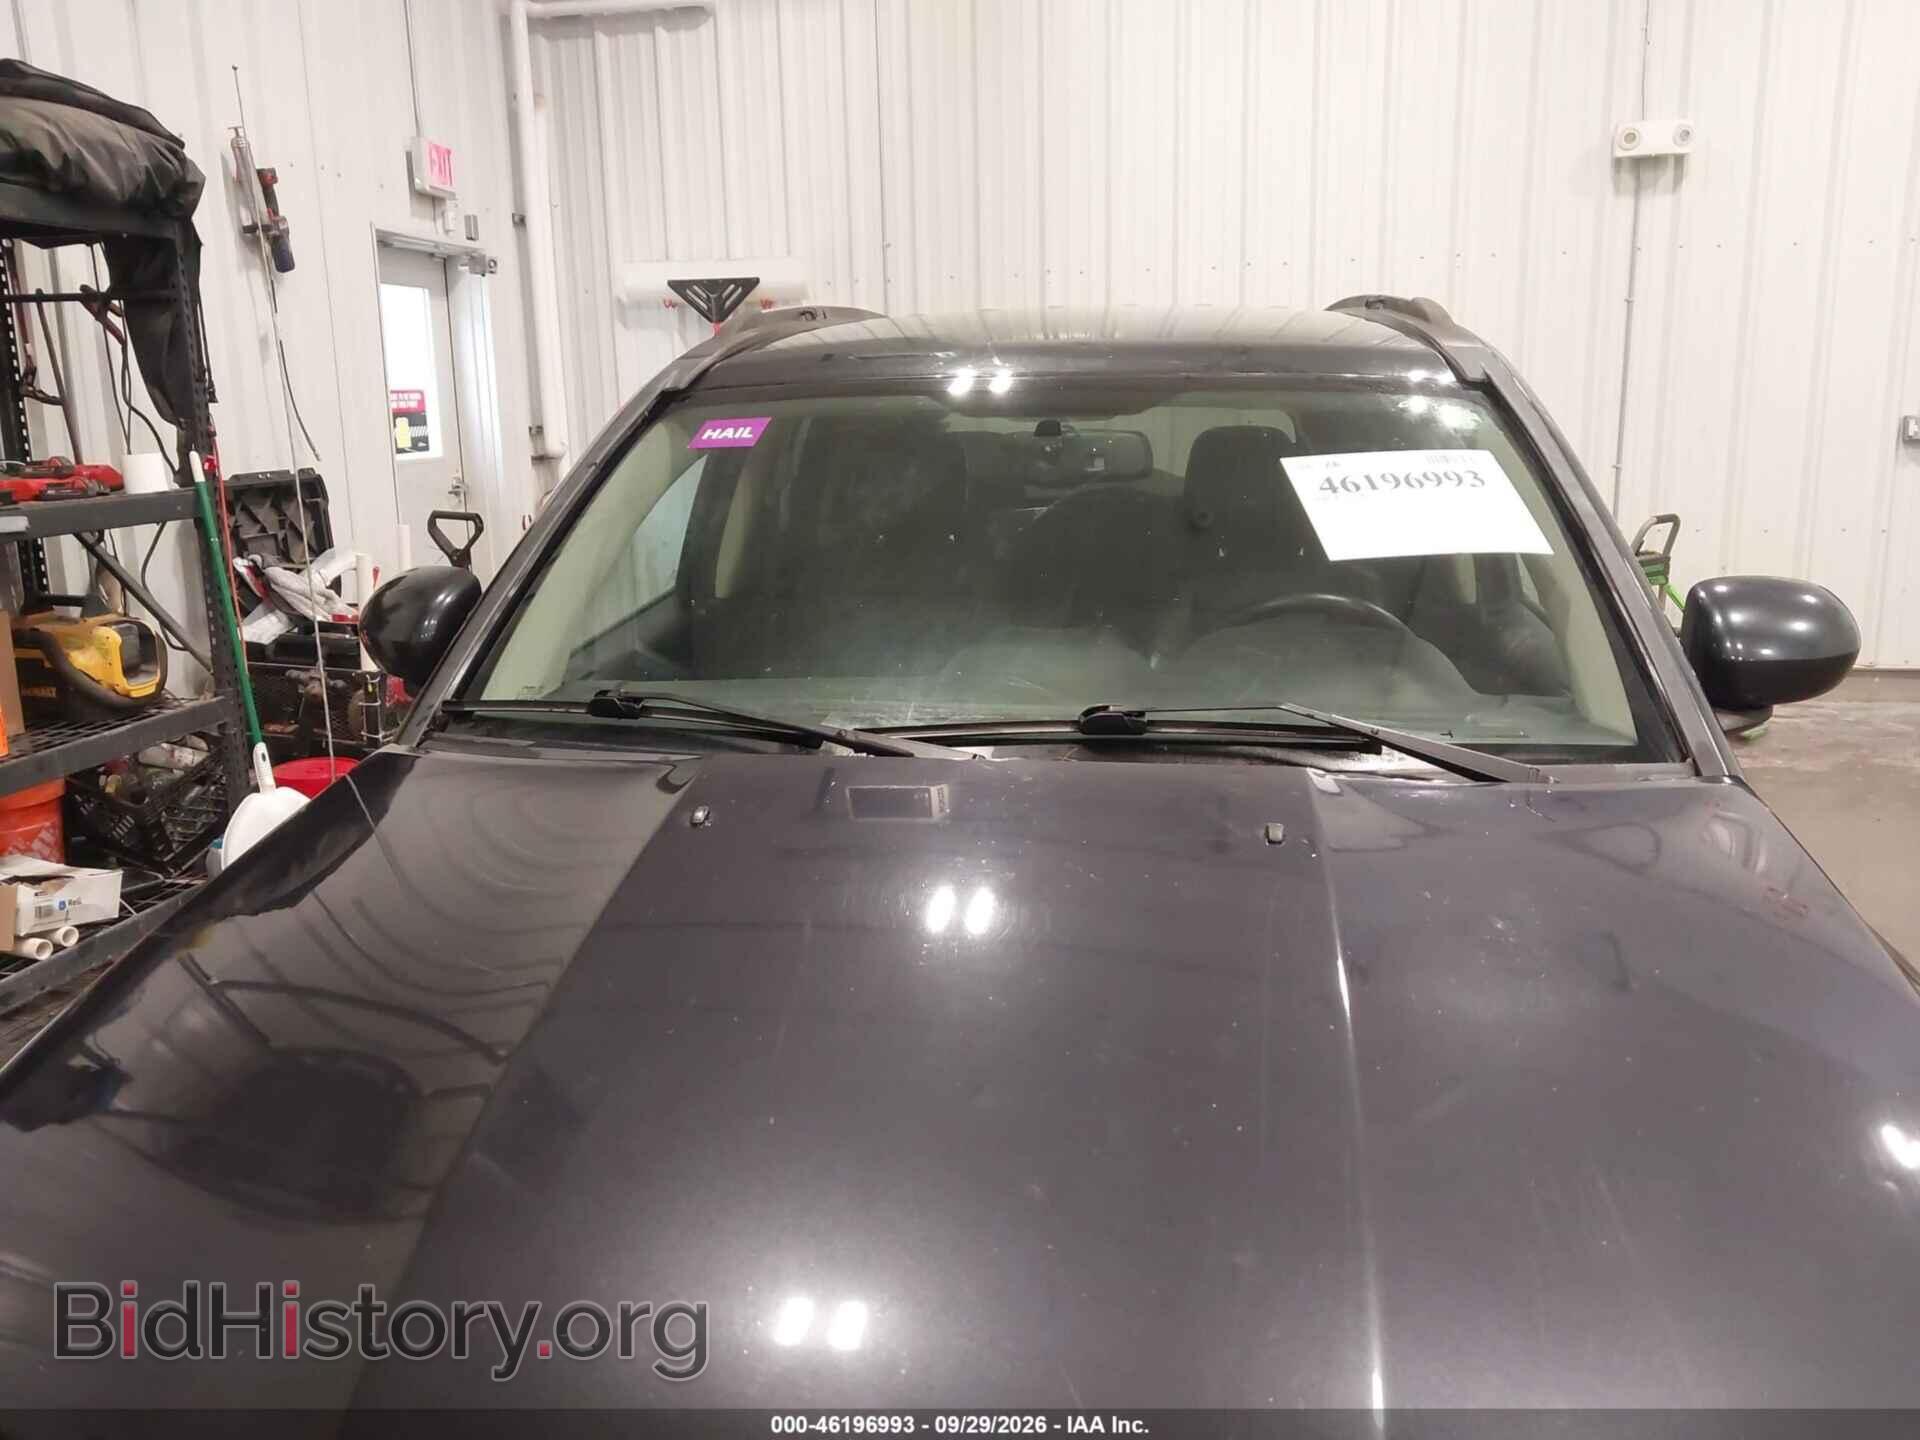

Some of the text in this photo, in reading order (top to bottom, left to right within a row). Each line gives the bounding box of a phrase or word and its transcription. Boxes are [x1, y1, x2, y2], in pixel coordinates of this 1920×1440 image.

[428, 143, 453, 186] EXIT
[701, 426, 753, 440] HAIL
[1319, 469, 1486, 495] 46196993
